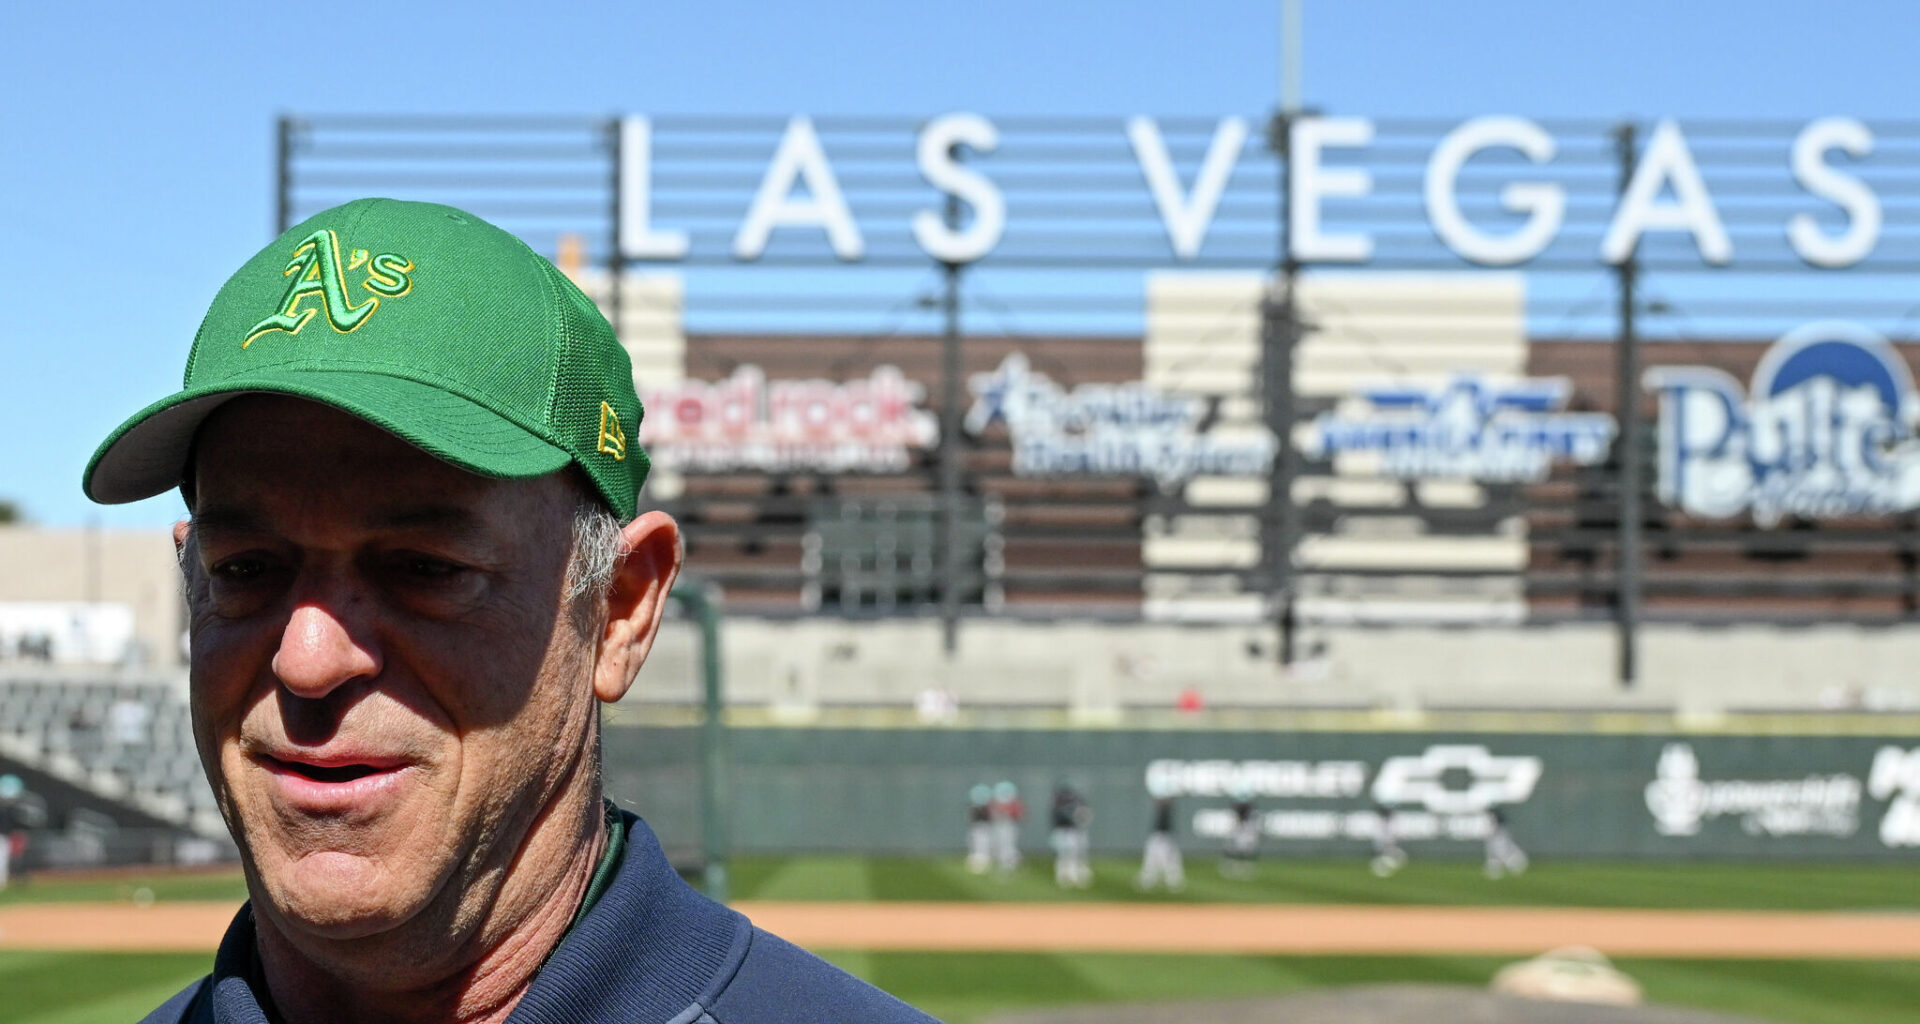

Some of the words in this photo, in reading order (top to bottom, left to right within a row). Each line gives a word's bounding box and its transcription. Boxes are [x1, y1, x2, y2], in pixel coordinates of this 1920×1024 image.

[619, 112, 1006, 262] LAS
[1127, 114, 1882, 266] VEGAS
[242, 229, 415, 349] A's
